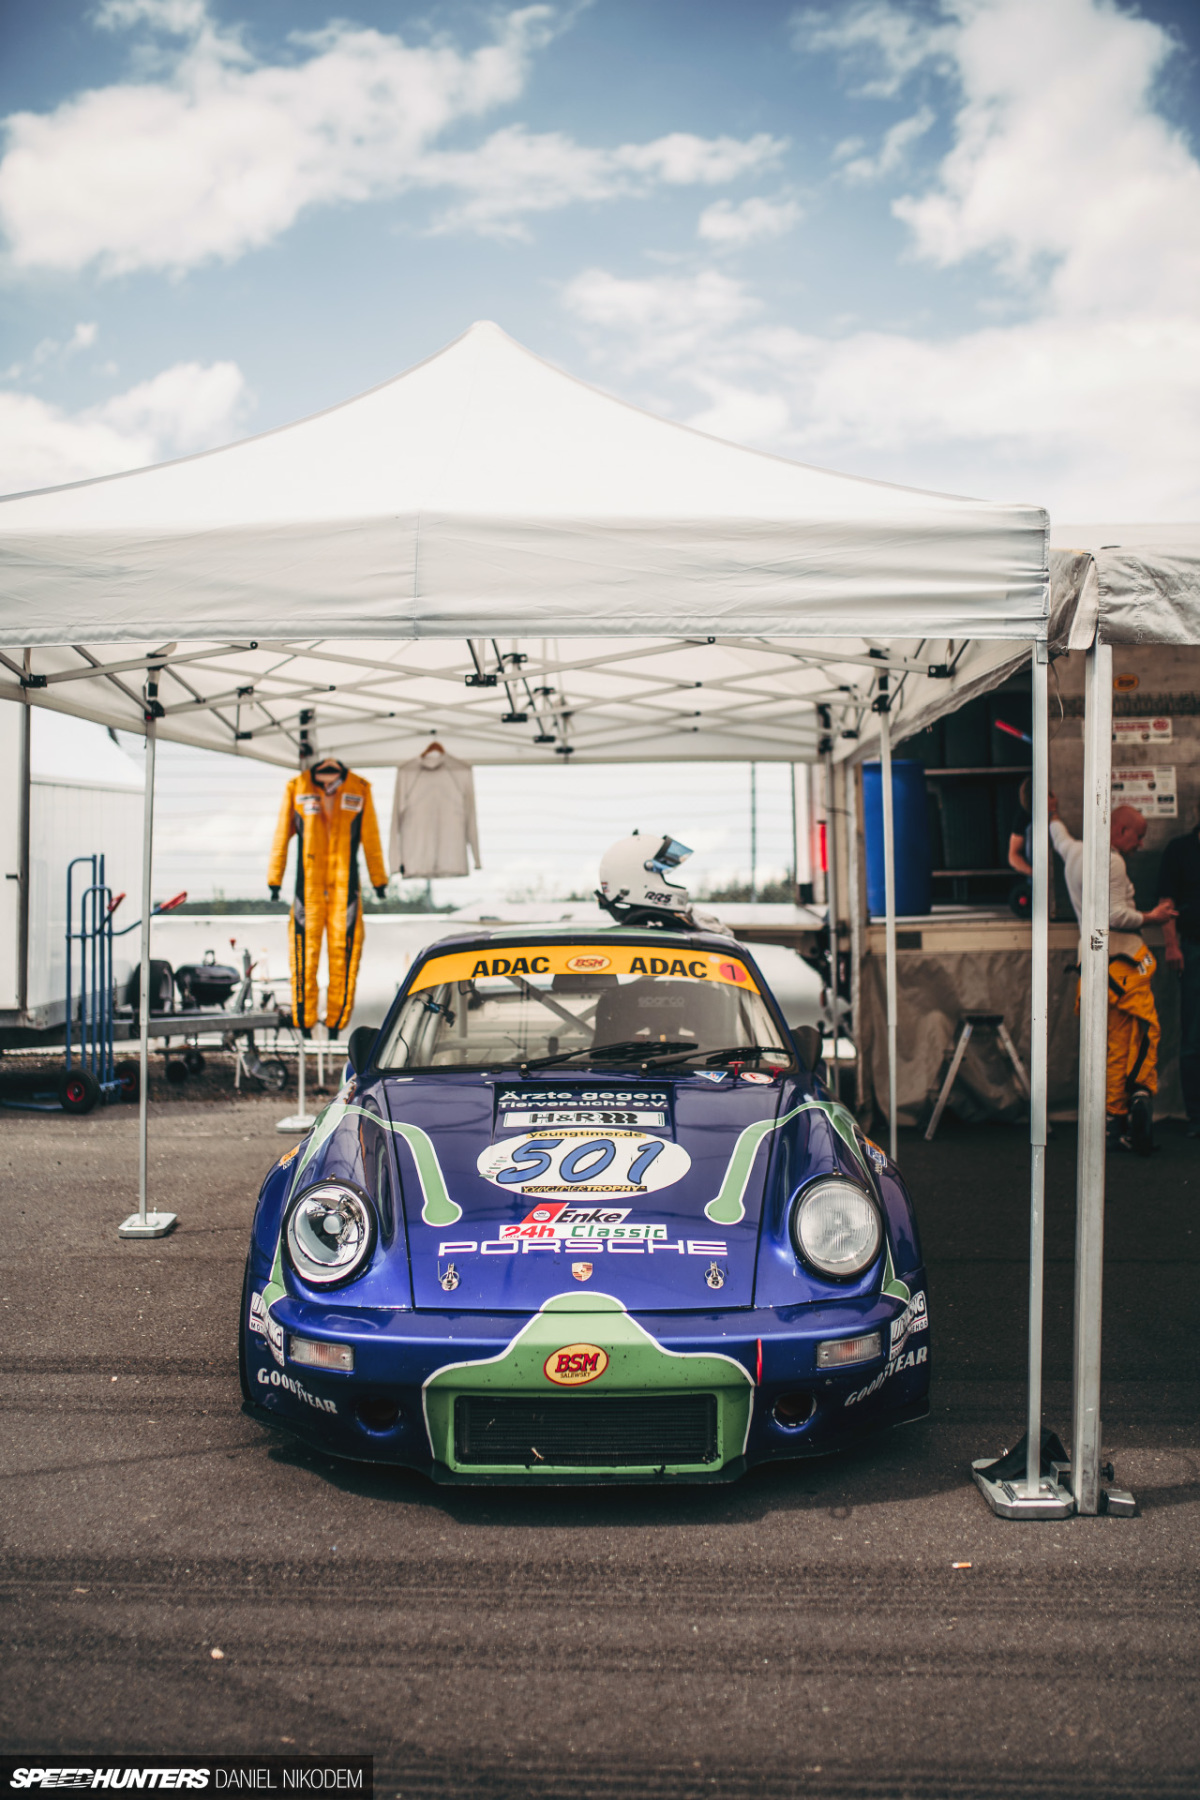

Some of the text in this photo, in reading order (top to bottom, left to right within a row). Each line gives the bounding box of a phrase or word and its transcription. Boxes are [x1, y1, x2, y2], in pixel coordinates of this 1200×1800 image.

[471, 956, 550, 978] ADAC
[573, 958, 604, 968] BSM
[629, 957, 707, 979] ADAC
[726, 964, 738, 980] 1
[499, 1090, 668, 1101] Ärzte gegen
[529, 1112, 597, 1125] H&R
[528, 1131, 643, 1139] youngtimer.de
[496, 1139, 665, 1184] 501
[554, 1209, 623, 1224] Enke
[504, 1225, 665, 1239] 24h Classic
[438, 1239, 728, 1257] PORSCHE
[555, 1353, 600, 1372] BSM
[844, 1346, 928, 1407] GOODYEAR
[257, 1368, 338, 1414] GOODYEAR
